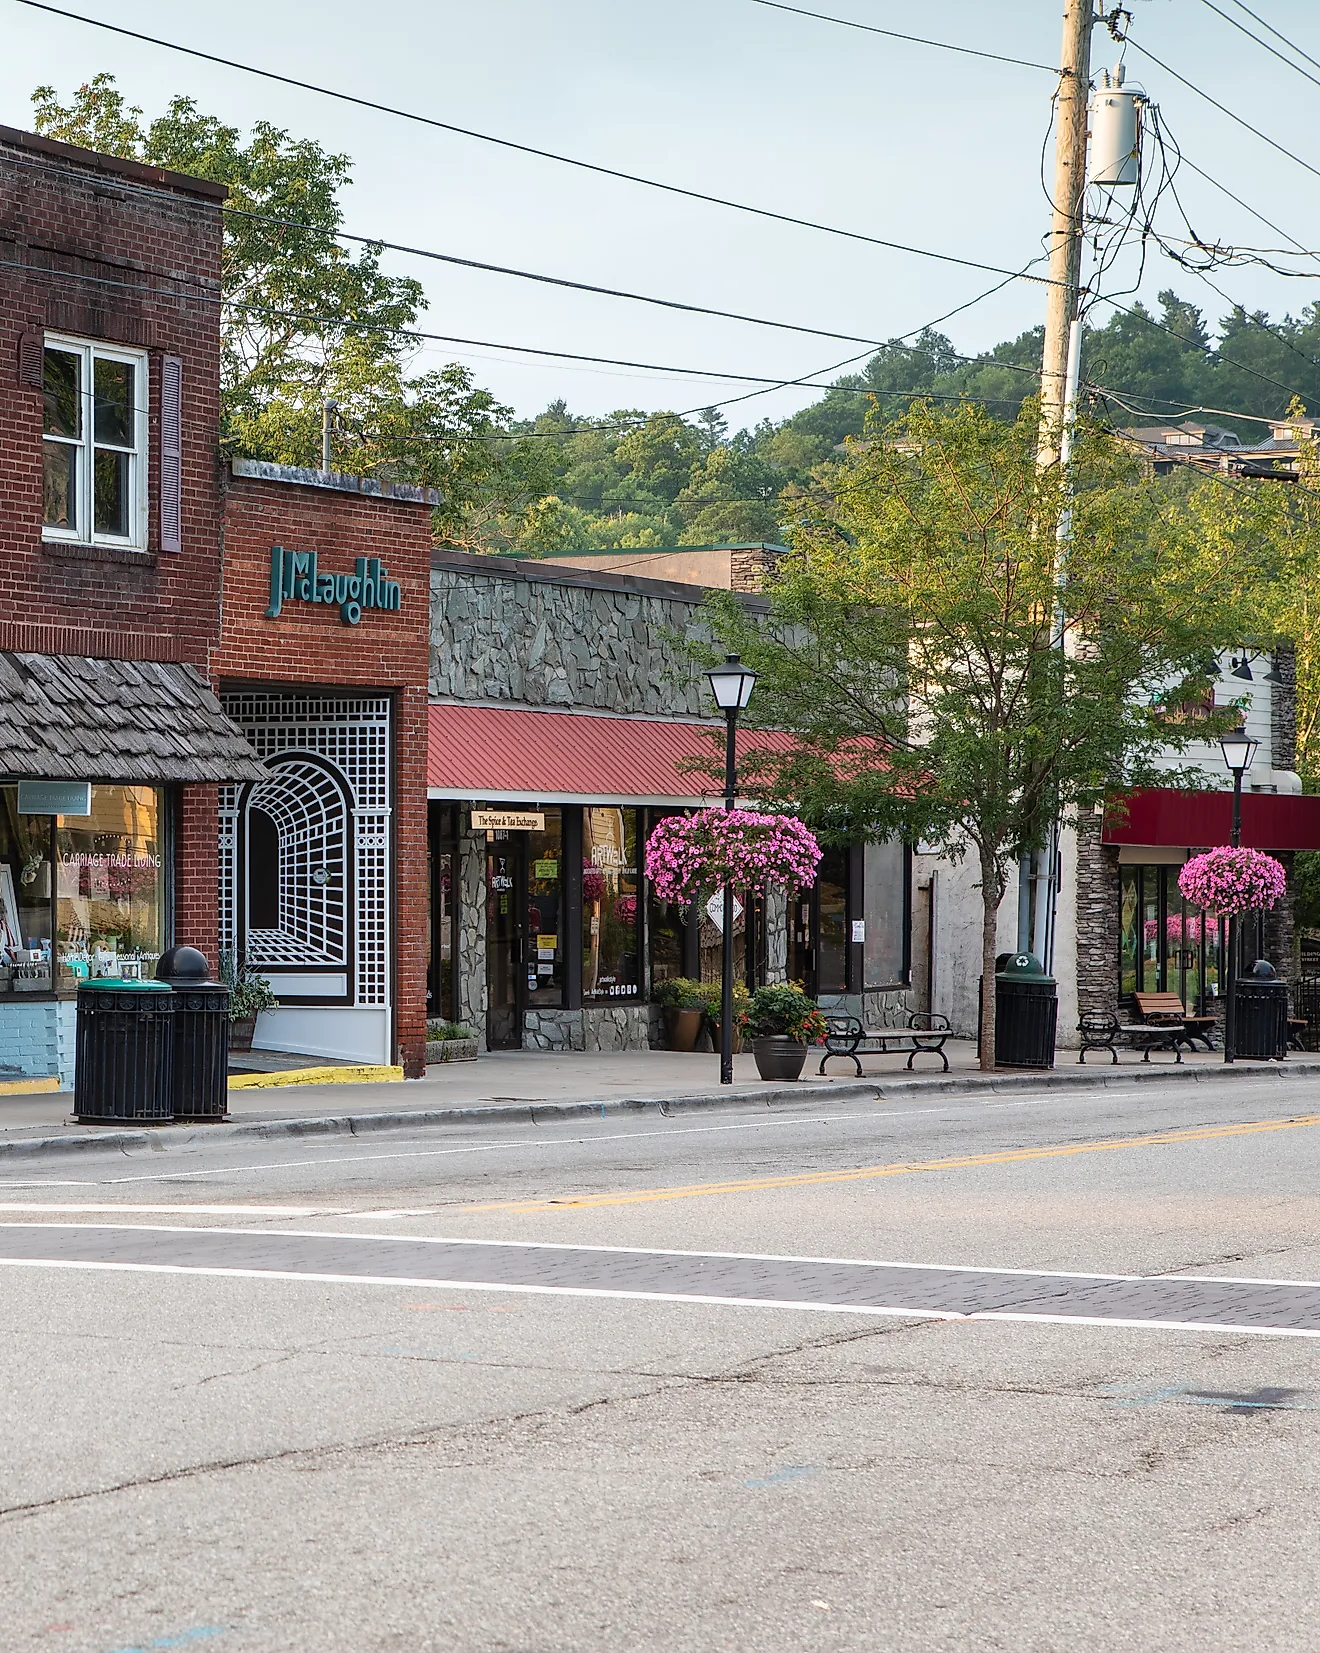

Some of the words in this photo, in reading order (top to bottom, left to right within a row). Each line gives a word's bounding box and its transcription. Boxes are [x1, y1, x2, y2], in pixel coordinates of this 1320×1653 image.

[478, 815, 488, 826] The
[488, 815, 501, 828] Spice
[501, 816, 507, 826] &
[506, 816, 516, 826] Tea
[516, 816, 538, 829] Exchange
[62, 852, 104, 867] CARRIAGE
[105, 853, 131, 867] TRADE
[133, 854, 162, 868] LIVING
